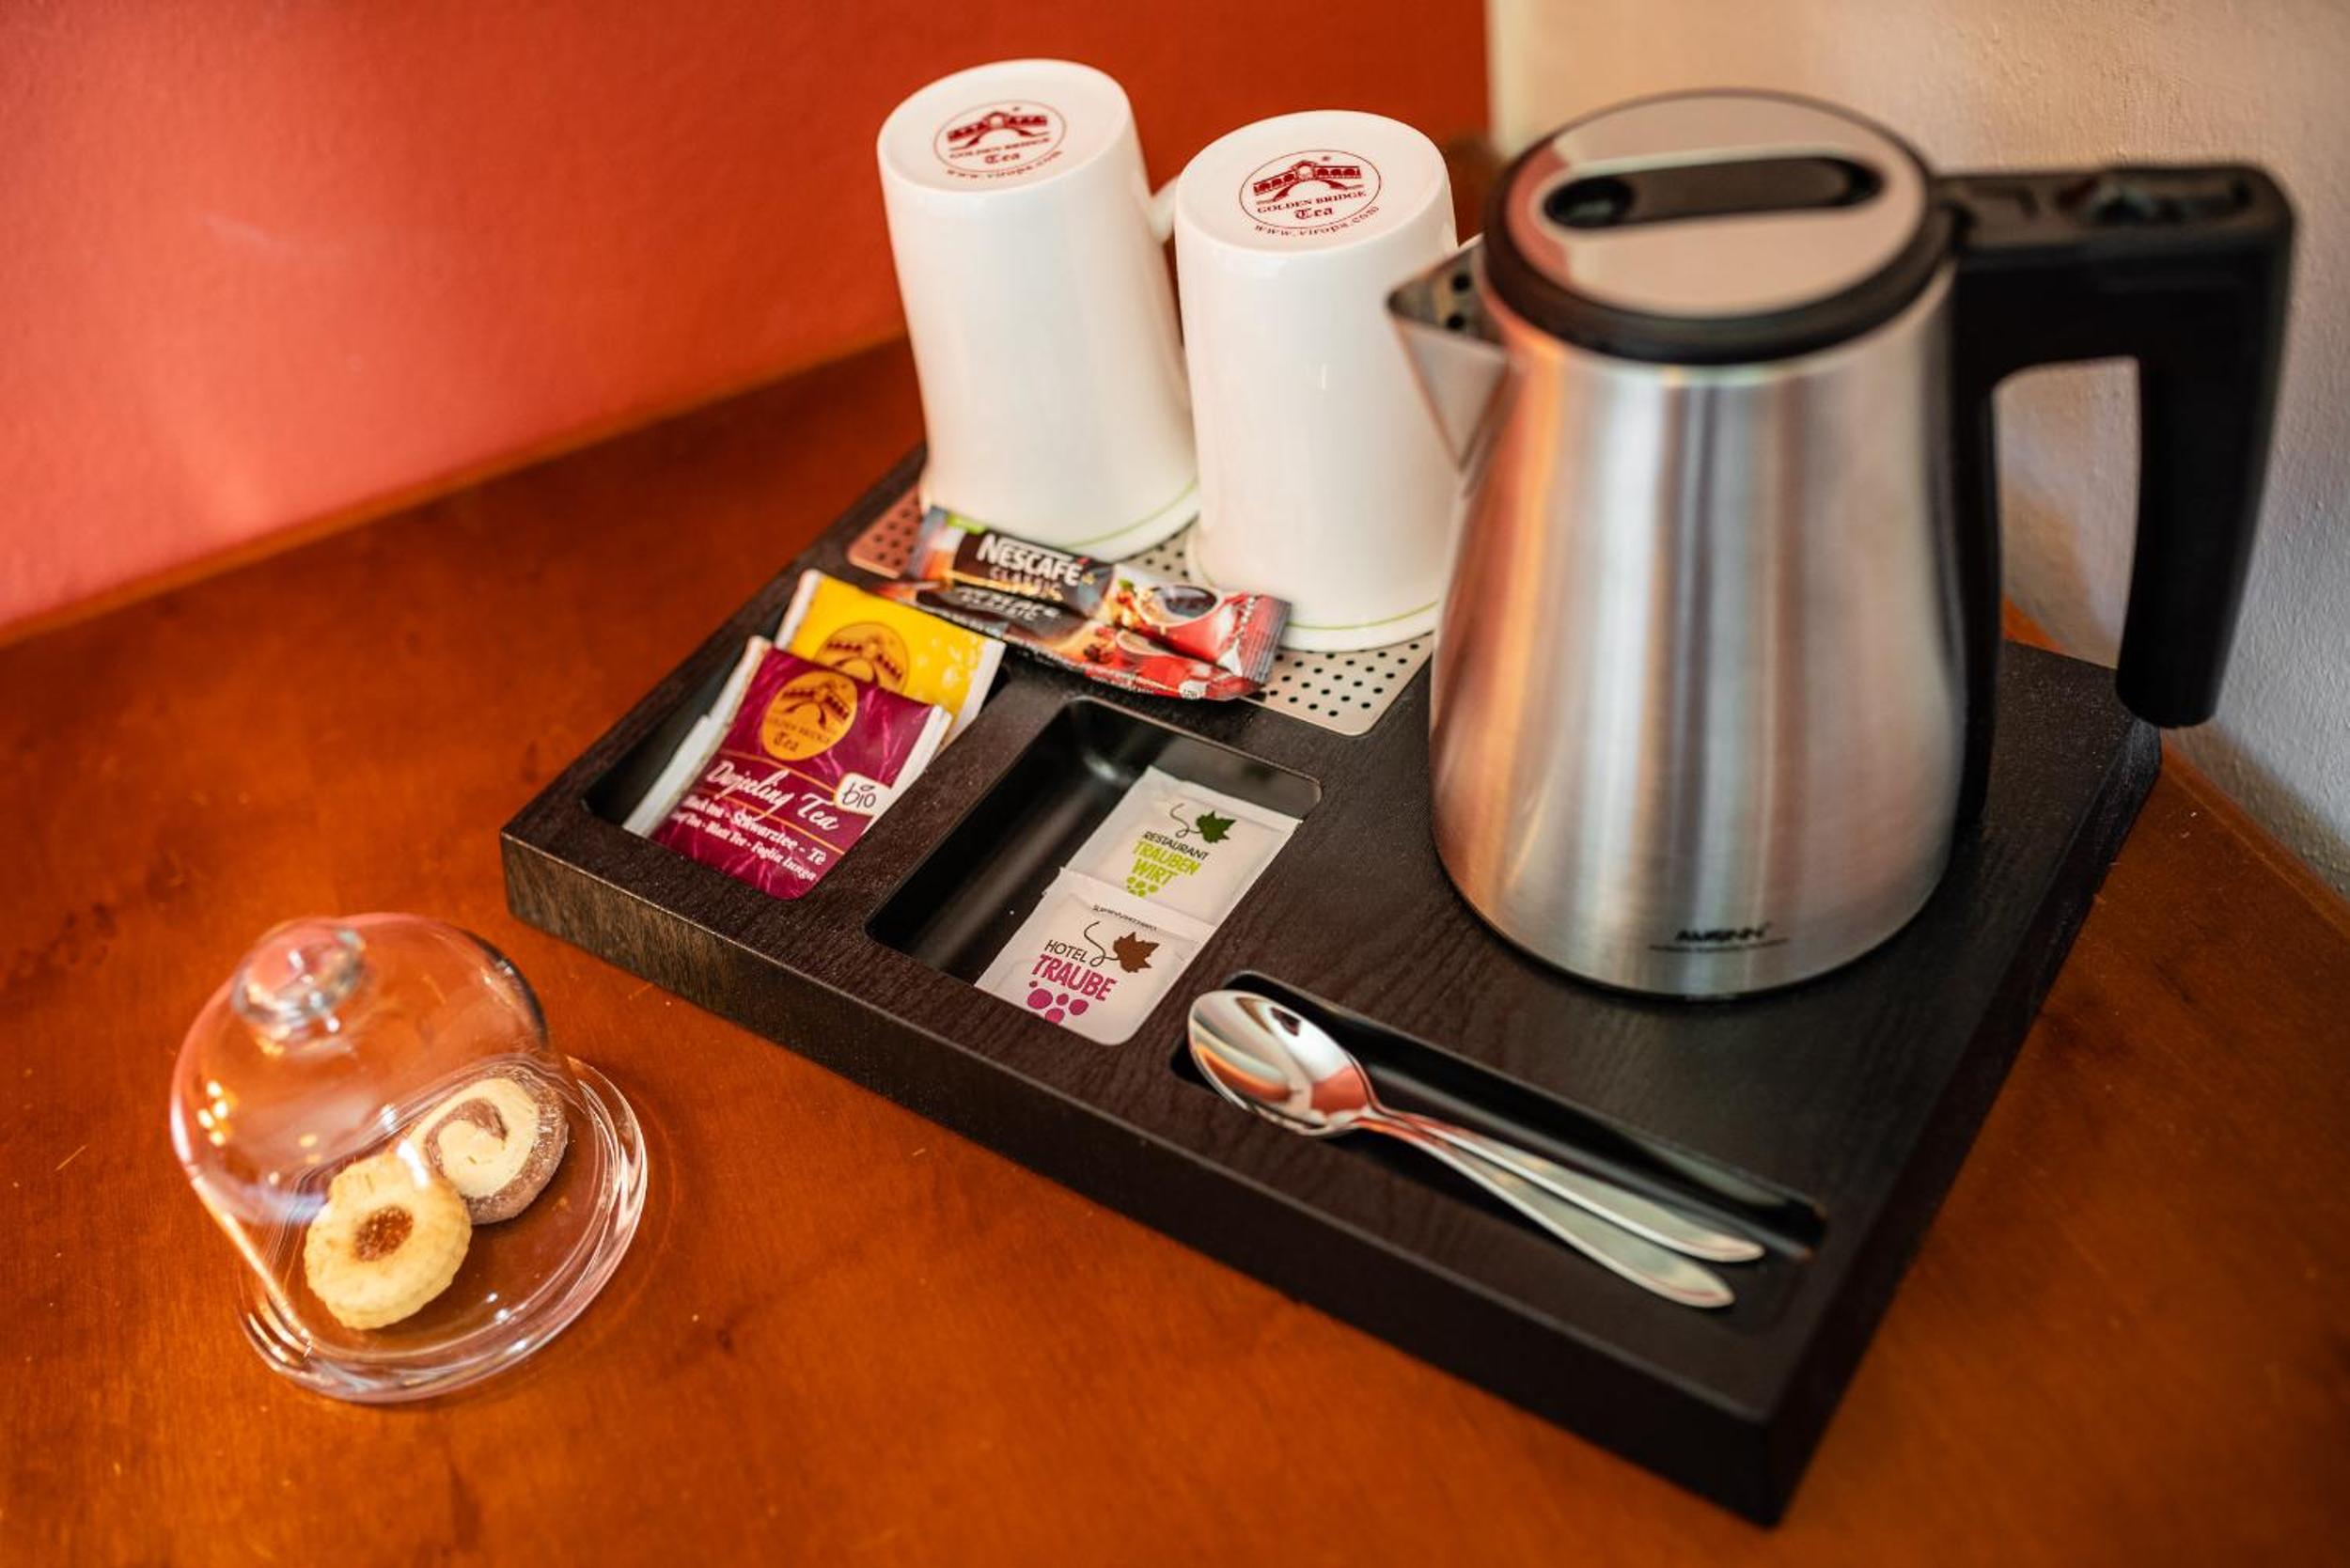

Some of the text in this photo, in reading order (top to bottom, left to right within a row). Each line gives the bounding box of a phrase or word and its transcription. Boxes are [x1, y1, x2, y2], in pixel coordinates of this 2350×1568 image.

[1257, 191, 1368, 214] GOLDEN BRIDGE
[1294, 207, 1335, 220] Tea
[841, 781, 876, 809] bio
[797, 792, 838, 831] Tea
[1133, 840, 1201, 876] TRAUBEN
[1142, 831, 1210, 860] RESTAURANT
[1131, 857, 1178, 886] WIRT
[1043, 939, 1089, 964] HOTEL
[1030, 953, 1118, 1002] TRAUBE
